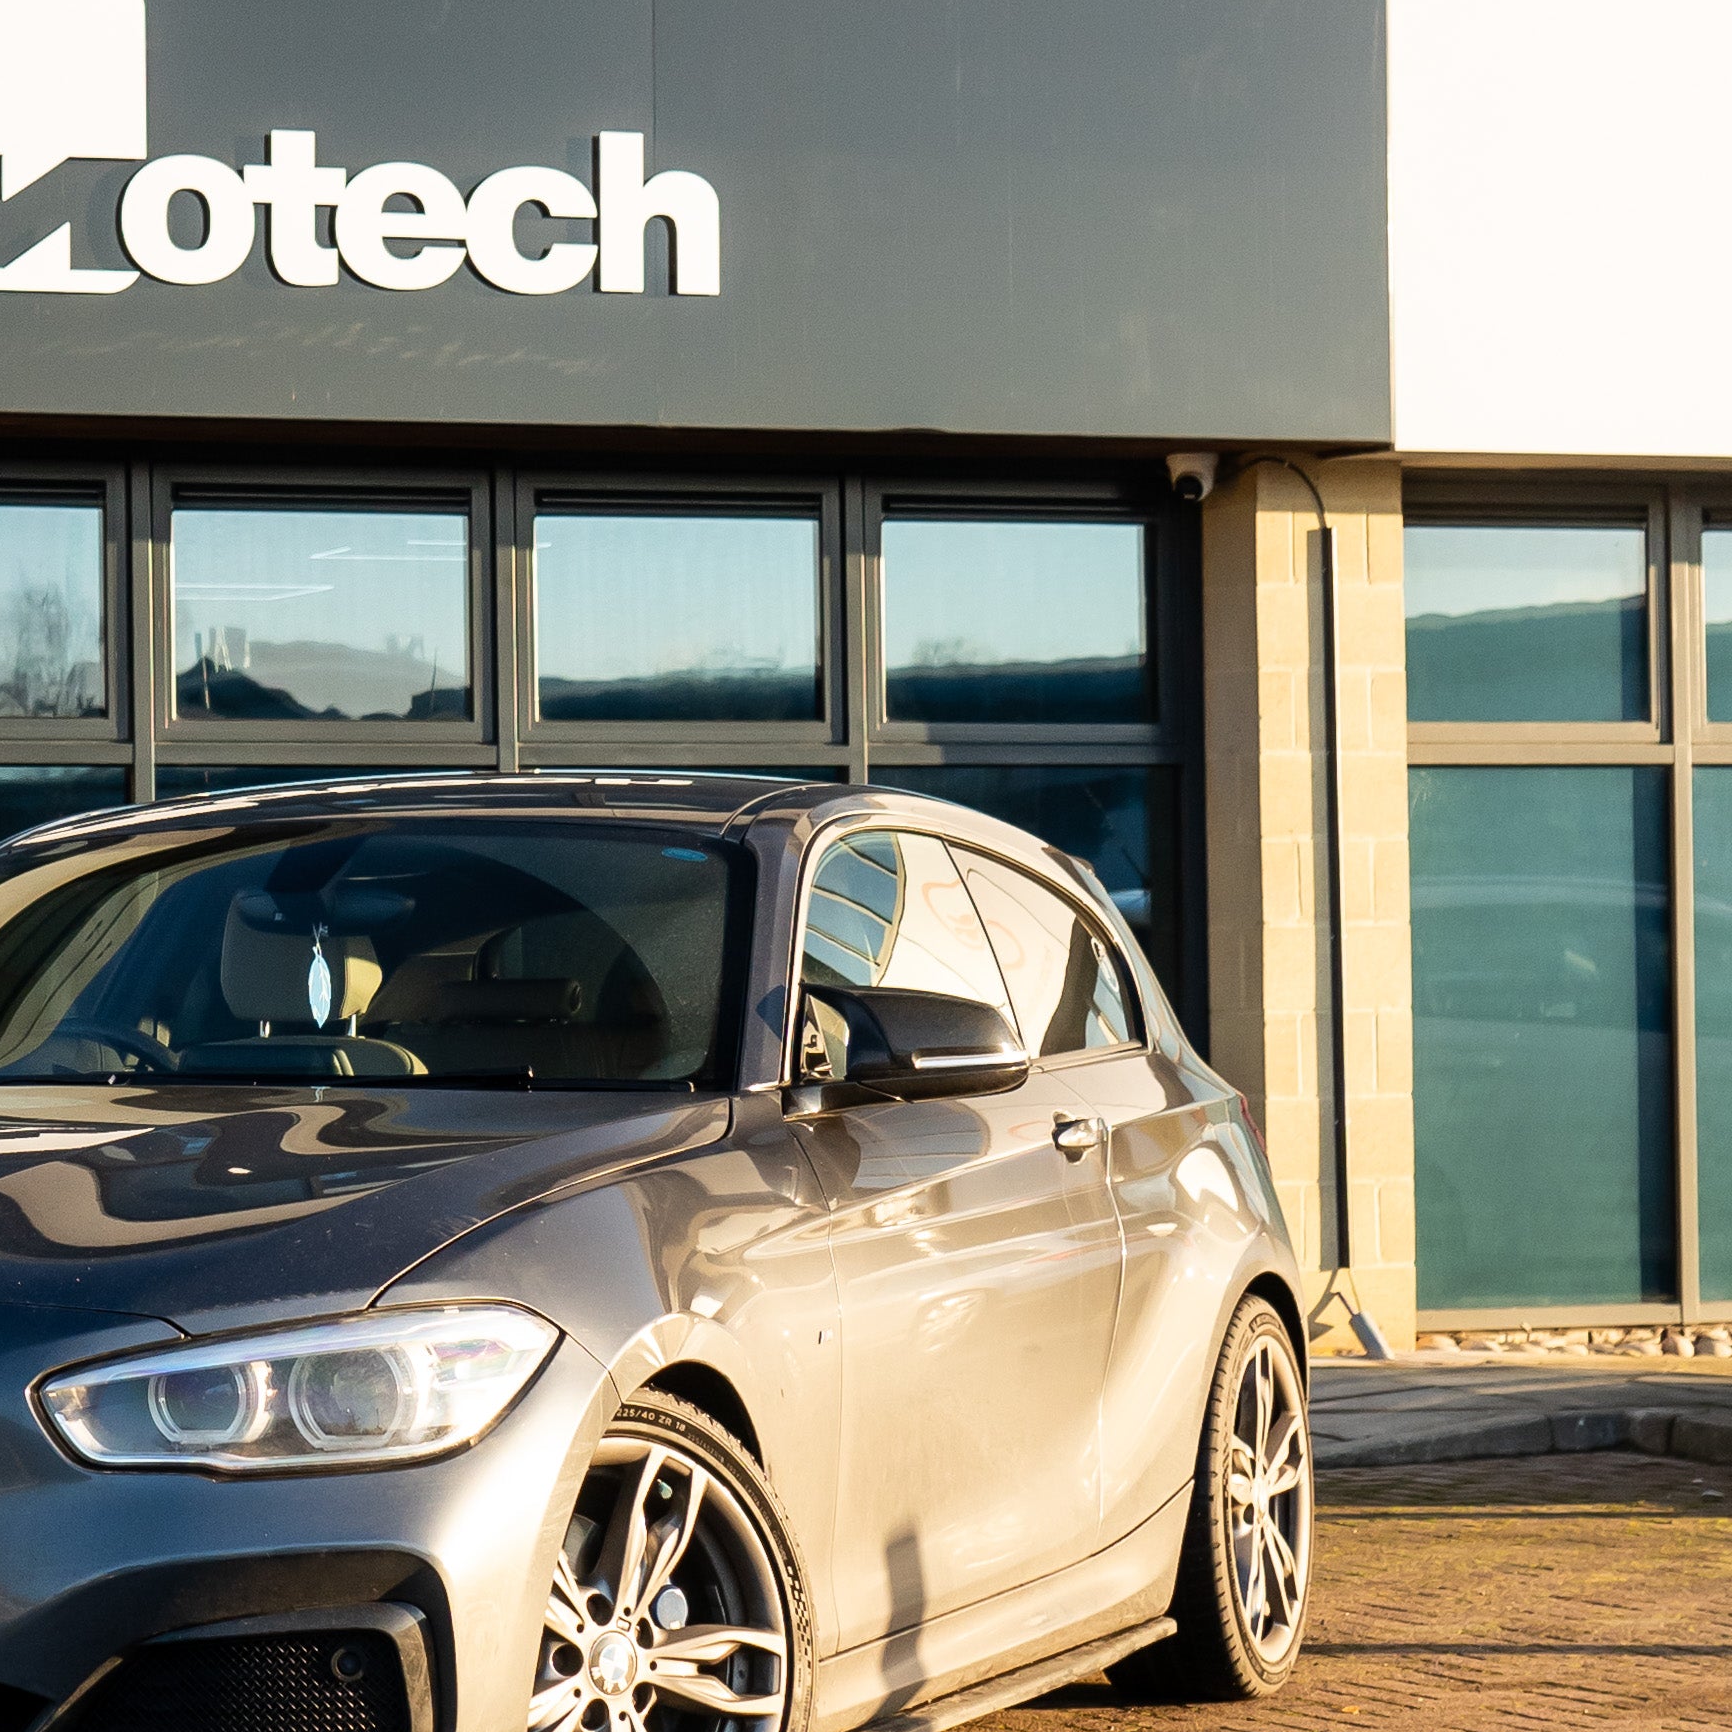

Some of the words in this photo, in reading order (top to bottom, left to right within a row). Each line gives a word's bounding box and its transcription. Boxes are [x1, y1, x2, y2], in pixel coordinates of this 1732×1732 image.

[616, 1407, 656, 1421] 225/40
[658, 1414, 673, 1426] ZR
[675, 1421, 686, 1432] 18
